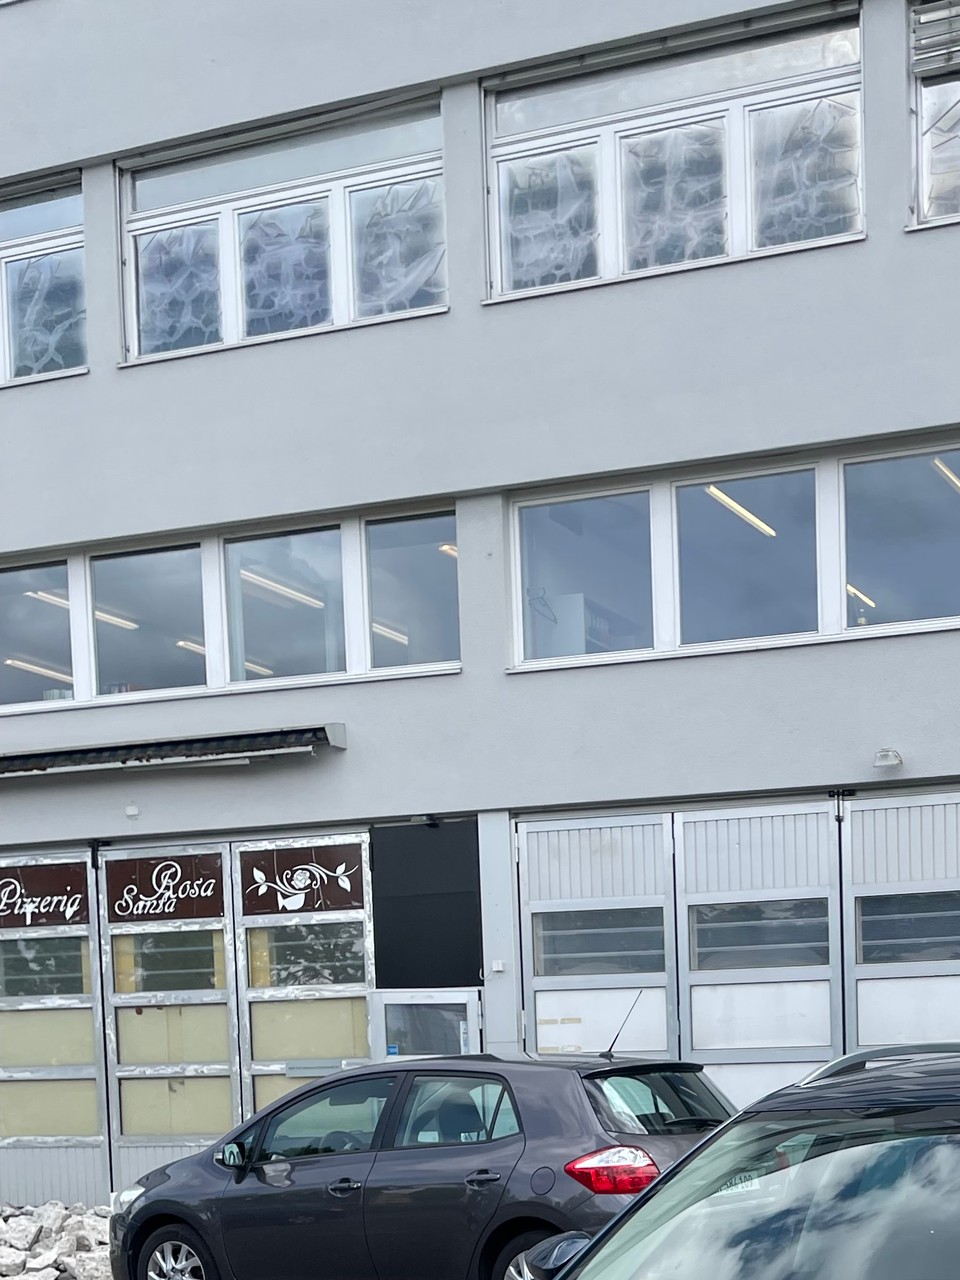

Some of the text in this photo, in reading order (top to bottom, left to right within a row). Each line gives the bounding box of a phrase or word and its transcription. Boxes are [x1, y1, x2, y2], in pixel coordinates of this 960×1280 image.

[0, 878, 82, 920] Pizzeria
[115, 861, 216, 915] Santa Rosa
